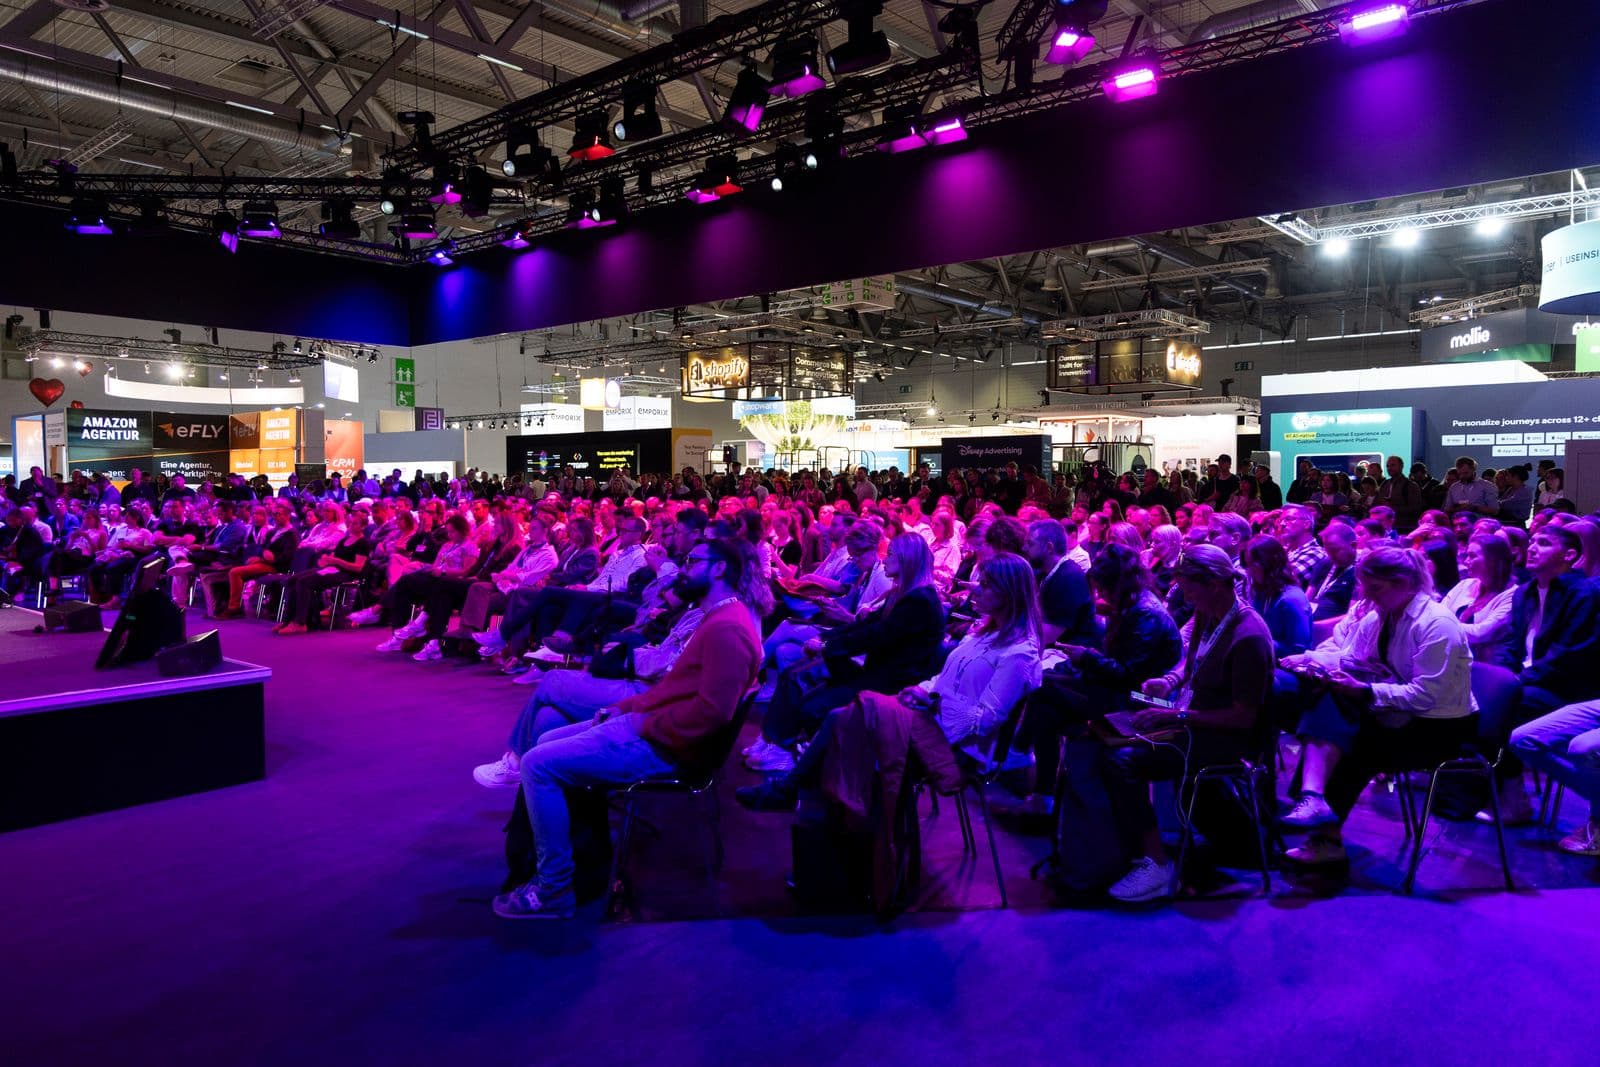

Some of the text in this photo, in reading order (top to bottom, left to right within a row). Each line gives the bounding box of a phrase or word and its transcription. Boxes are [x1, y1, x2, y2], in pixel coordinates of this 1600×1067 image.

[1450, 325, 1491, 348] mollie
[705, 357, 747, 378] shopify
[795, 356, 845, 370] Commerce built
[83, 416, 137, 428] AMAZON
[1452, 419, 1500, 427] Personalize
[1501, 418, 1540, 427] journeys
[81, 429, 140, 440] AGENTUR
[176, 424, 225, 438] eFLY
[958, 444, 1023, 458] Disney Advertising
[160, 461, 213, 470] Eine Agentur,
[333, 458, 356, 468] CRM
